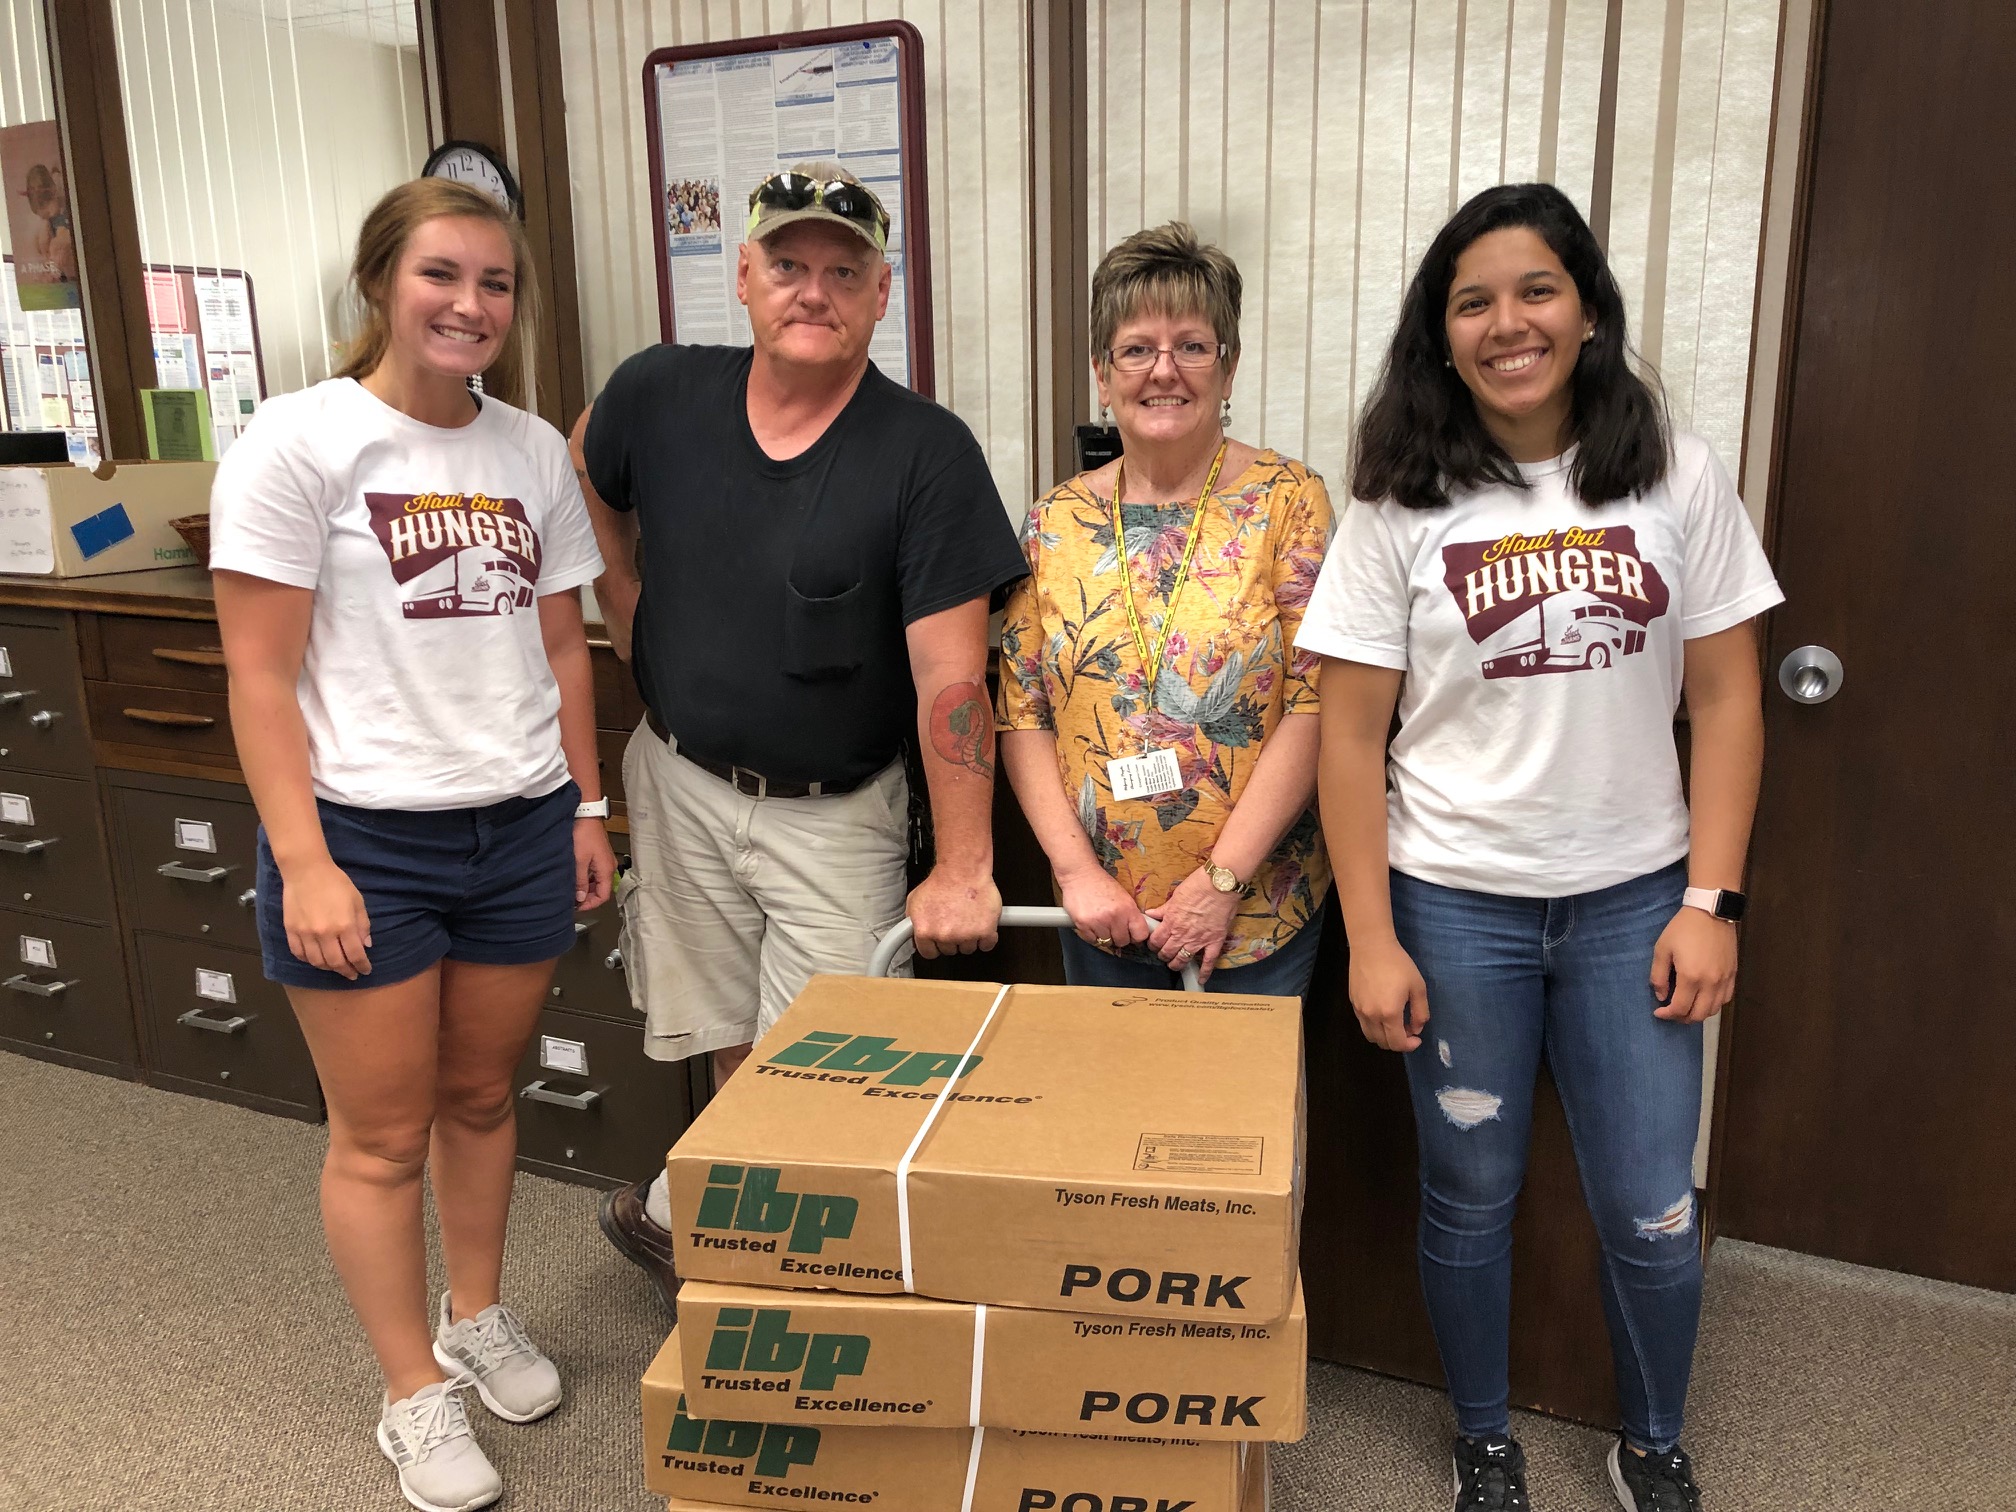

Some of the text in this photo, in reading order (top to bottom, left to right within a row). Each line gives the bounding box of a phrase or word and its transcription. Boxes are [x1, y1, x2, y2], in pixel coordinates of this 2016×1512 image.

[447, 162, 458, 180] 11
[460, 154, 474, 172] 12
[480, 161, 486, 177] 1
[490, 176, 500, 193] 2
[404, 491, 505, 513] Haul Out
[388, 508, 537, 567] HUNGER
[1482, 525, 1607, 562] Haul Out
[1464, 548, 1651, 620] HUNGER
[766, 1031, 984, 1086] ibp
[755, 1065, 870, 1085] Trusted
[861, 1087, 1033, 1104] Excelence
[696, 1164, 859, 1255] ibp
[1054, 1188, 1257, 1216] Tyson Fresh Meats, Inc.
[690, 1232, 777, 1254] Trusted
[779, 1258, 905, 1282] Excellence
[1060, 1264, 1252, 1309] PORK
[1073, 1321, 1271, 1341] Tyson Fresh Meats, Inc.
[705, 1307, 871, 1391] ibp
[701, 1375, 791, 1392] Trusted
[794, 1396, 928, 1414] Excellence
[1079, 1390, 1266, 1427] PORK
[661, 1455, 745, 1476] Trusted
[747, 1480, 874, 1504] Excellence
